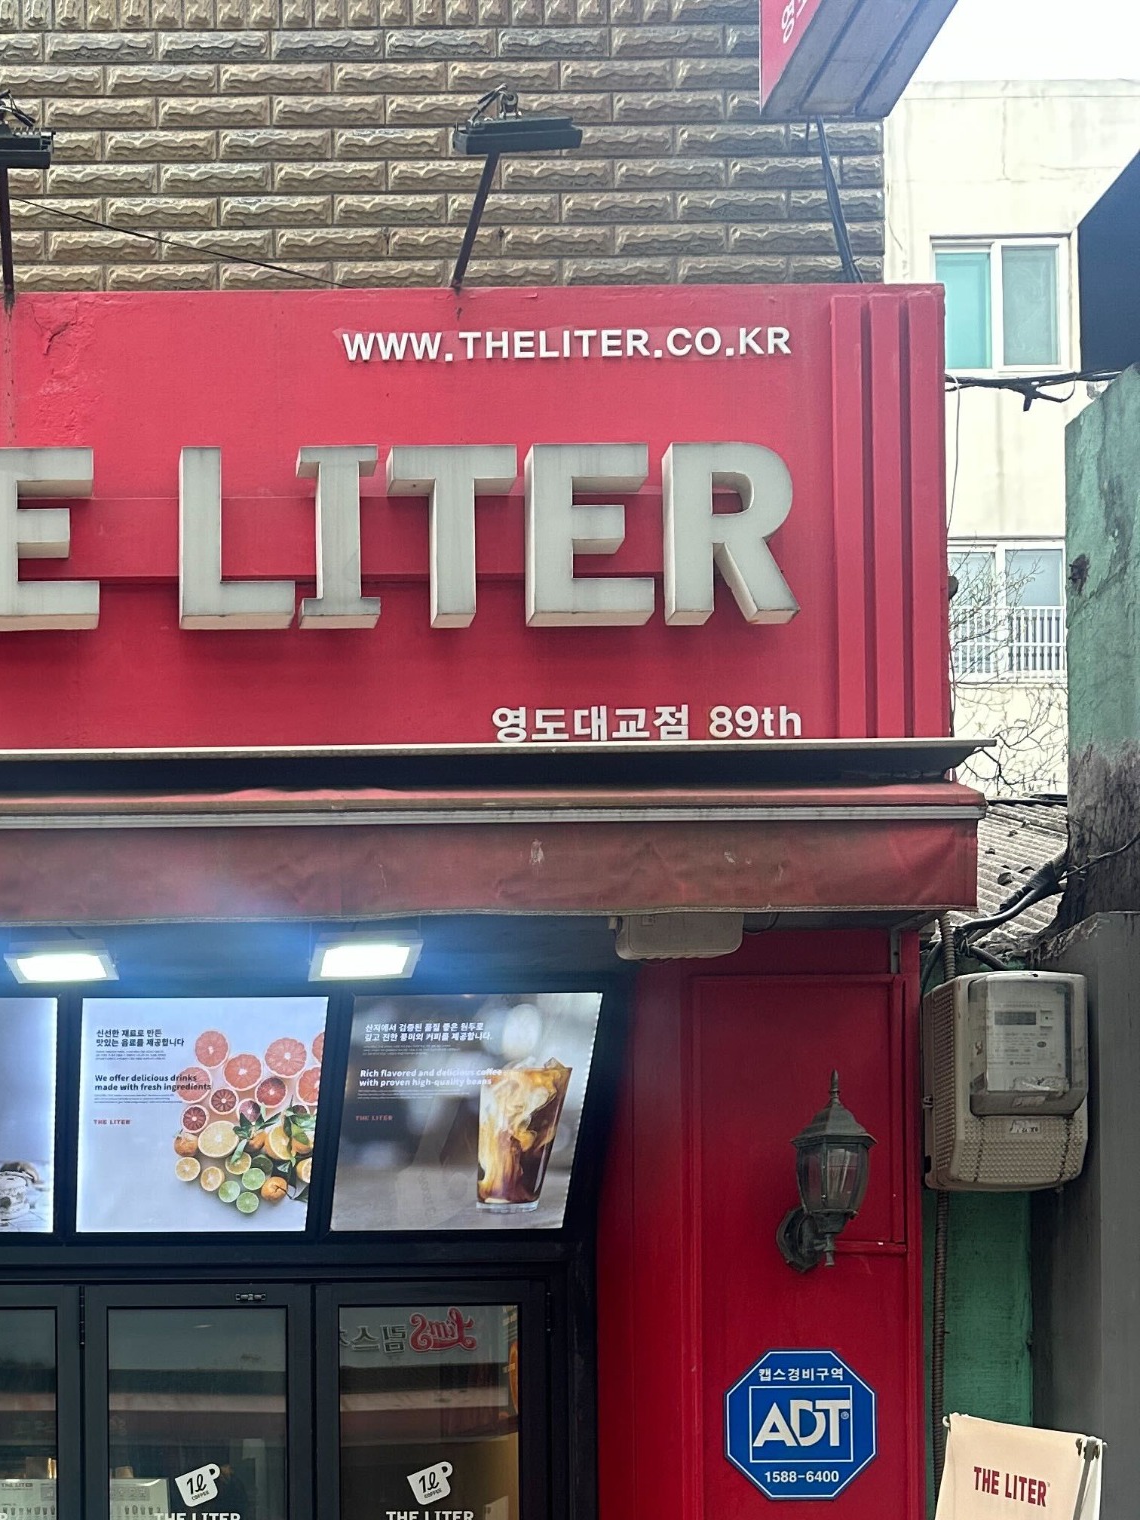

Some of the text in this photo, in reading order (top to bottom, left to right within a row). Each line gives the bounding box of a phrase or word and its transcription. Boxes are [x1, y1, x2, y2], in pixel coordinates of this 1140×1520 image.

[342, 326, 791, 363] WWW.THELITER.CO.KR
[178, 442, 801, 630] LITER
[491, 704, 803, 743] 영도대교점 89th
[96, 1029, 119, 1038] 신선한
[96, 1038, 119, 1047] 맛있는
[95, 1074, 197, 1082] We offer delicious drinks
[360, 1068, 503, 1077] Rich flavored and delicious coffee
[95, 1083, 212, 1092] made with fresh ingredients
[380, 1079, 410, 1088] proven
[412, 1078, 464, 1088] high-quality
[758, 1367, 844, 1382] 캡스경비구역
[752, 1400, 850, 1447] ADT
[764, 1470, 840, 1483] 1588-6400
[974, 1466, 1047, 1507] THE LITER
